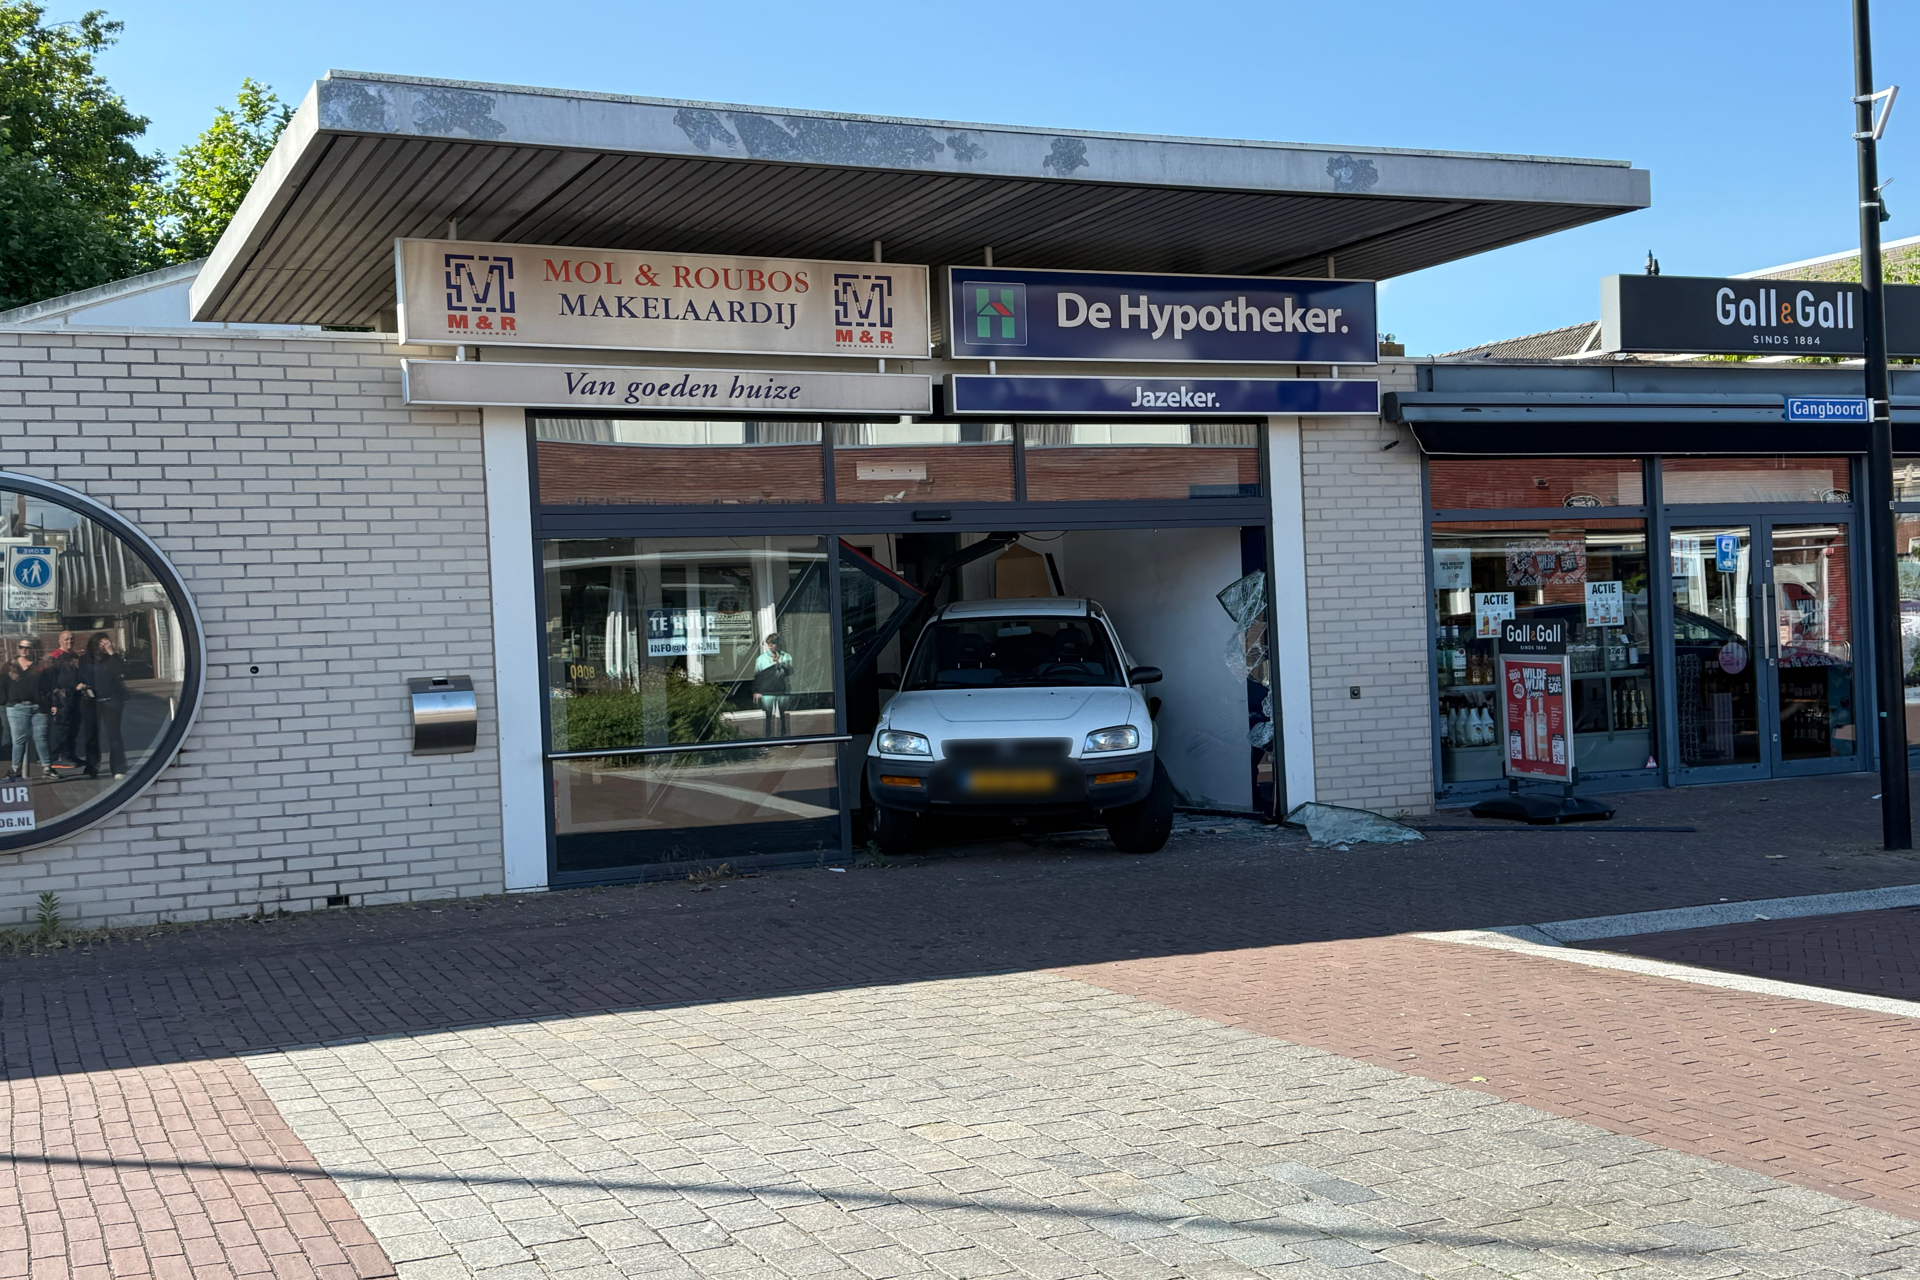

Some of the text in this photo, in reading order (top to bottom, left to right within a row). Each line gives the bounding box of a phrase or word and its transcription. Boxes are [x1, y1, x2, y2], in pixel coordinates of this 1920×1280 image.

[542, 258, 810, 294] MOL & ROUBOS
[558, 293, 798, 330] MAKELAARDIJ
[1057, 292, 1349, 340] De Hypotheker.
[448, 314, 516, 330] M & R
[835, 329, 893, 344] M & R
[1753, 335, 1821, 345] SINDS 1884
[564, 371, 802, 403] Van goeden huize
[1131, 386, 1221, 408] Jazeker.
[1793, 401, 1864, 419] Gangboord
[1592, 583, 1616, 594] ACTIE
[1483, 594, 1508, 605] ACTIE
[650, 617, 668, 631] TE
[670, 614, 716, 630] HUUR
[1522, 667, 1547, 679] WILDE
[1524, 679, 1545, 690] WIJN
